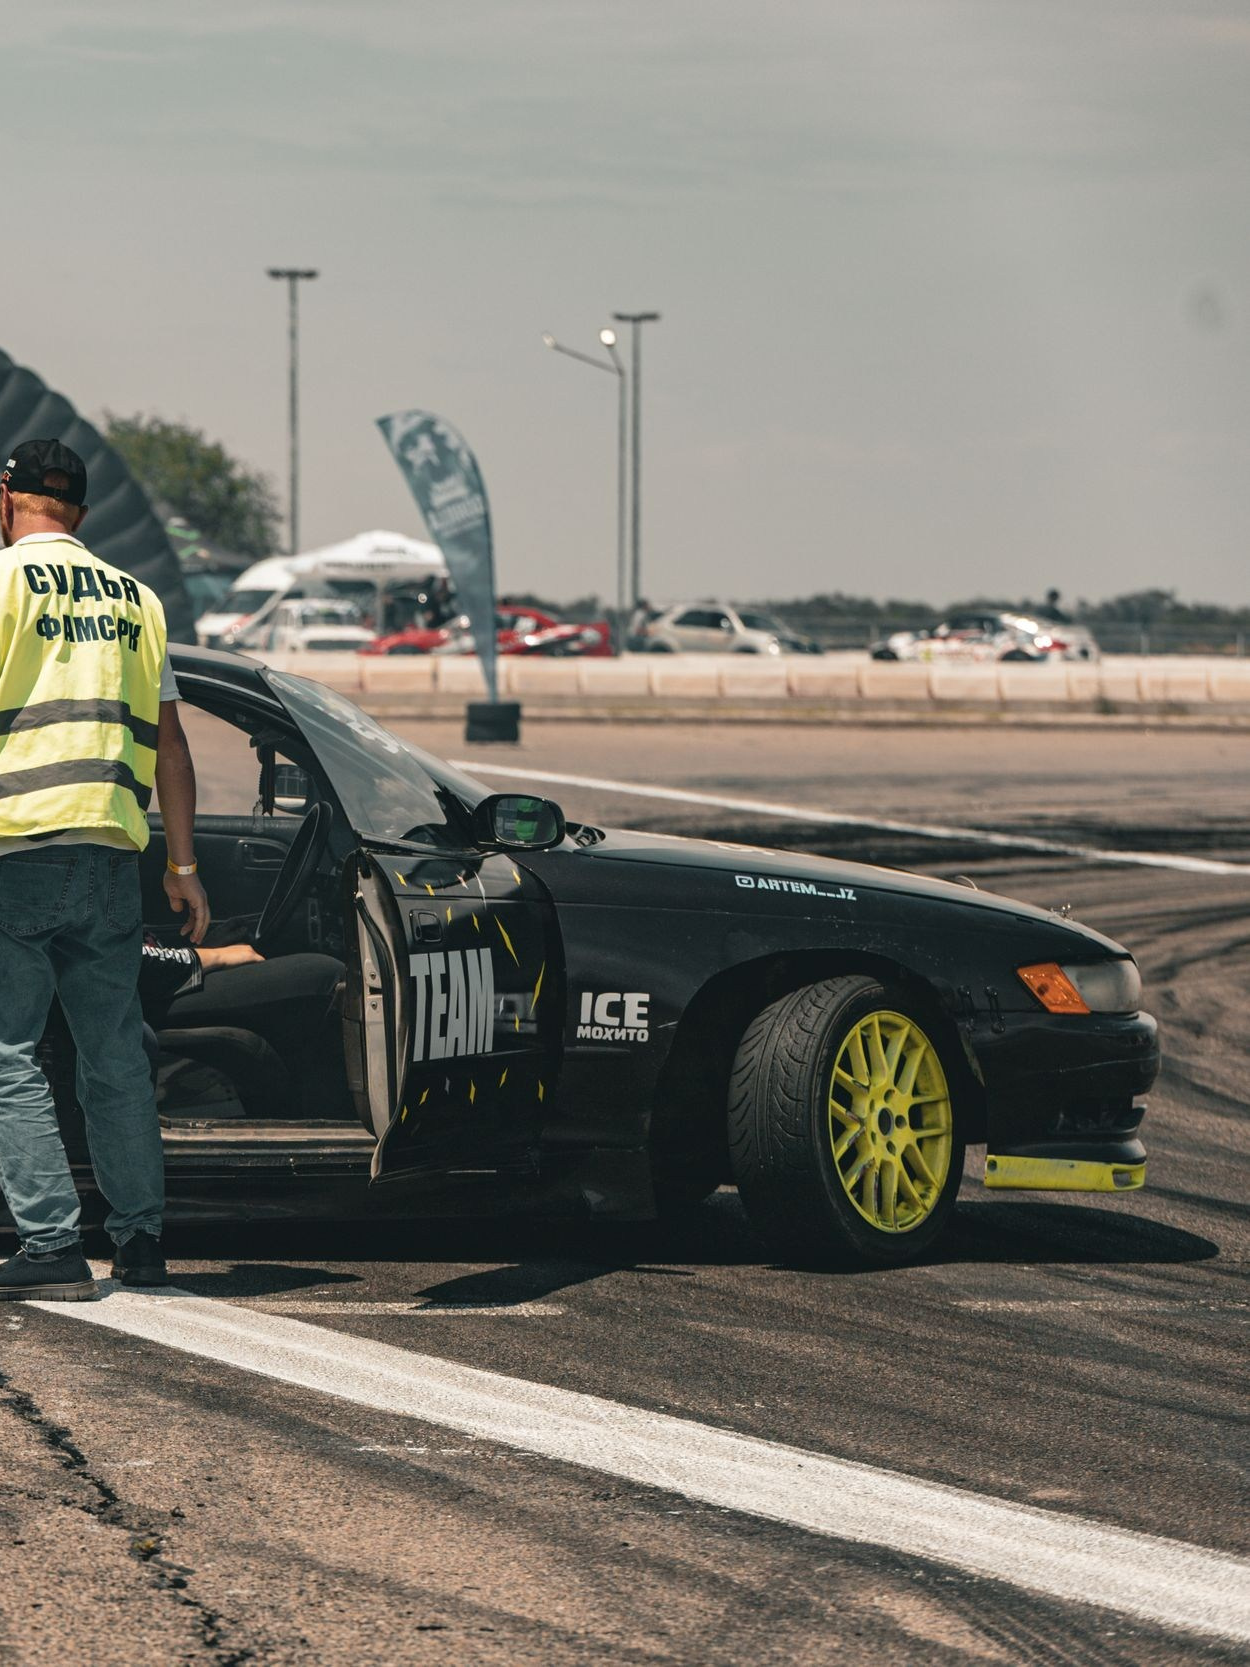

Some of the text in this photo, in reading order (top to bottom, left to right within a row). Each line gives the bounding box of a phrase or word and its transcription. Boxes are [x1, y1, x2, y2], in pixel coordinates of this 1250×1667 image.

[23, 563, 142, 608] СУДЬЯ
[35, 613, 143, 653] ФАМСРК
[408, 947, 495, 1062] TEAM
[580, 992, 650, 1028] ICE
[576, 1025, 650, 1043] МОХИТО
